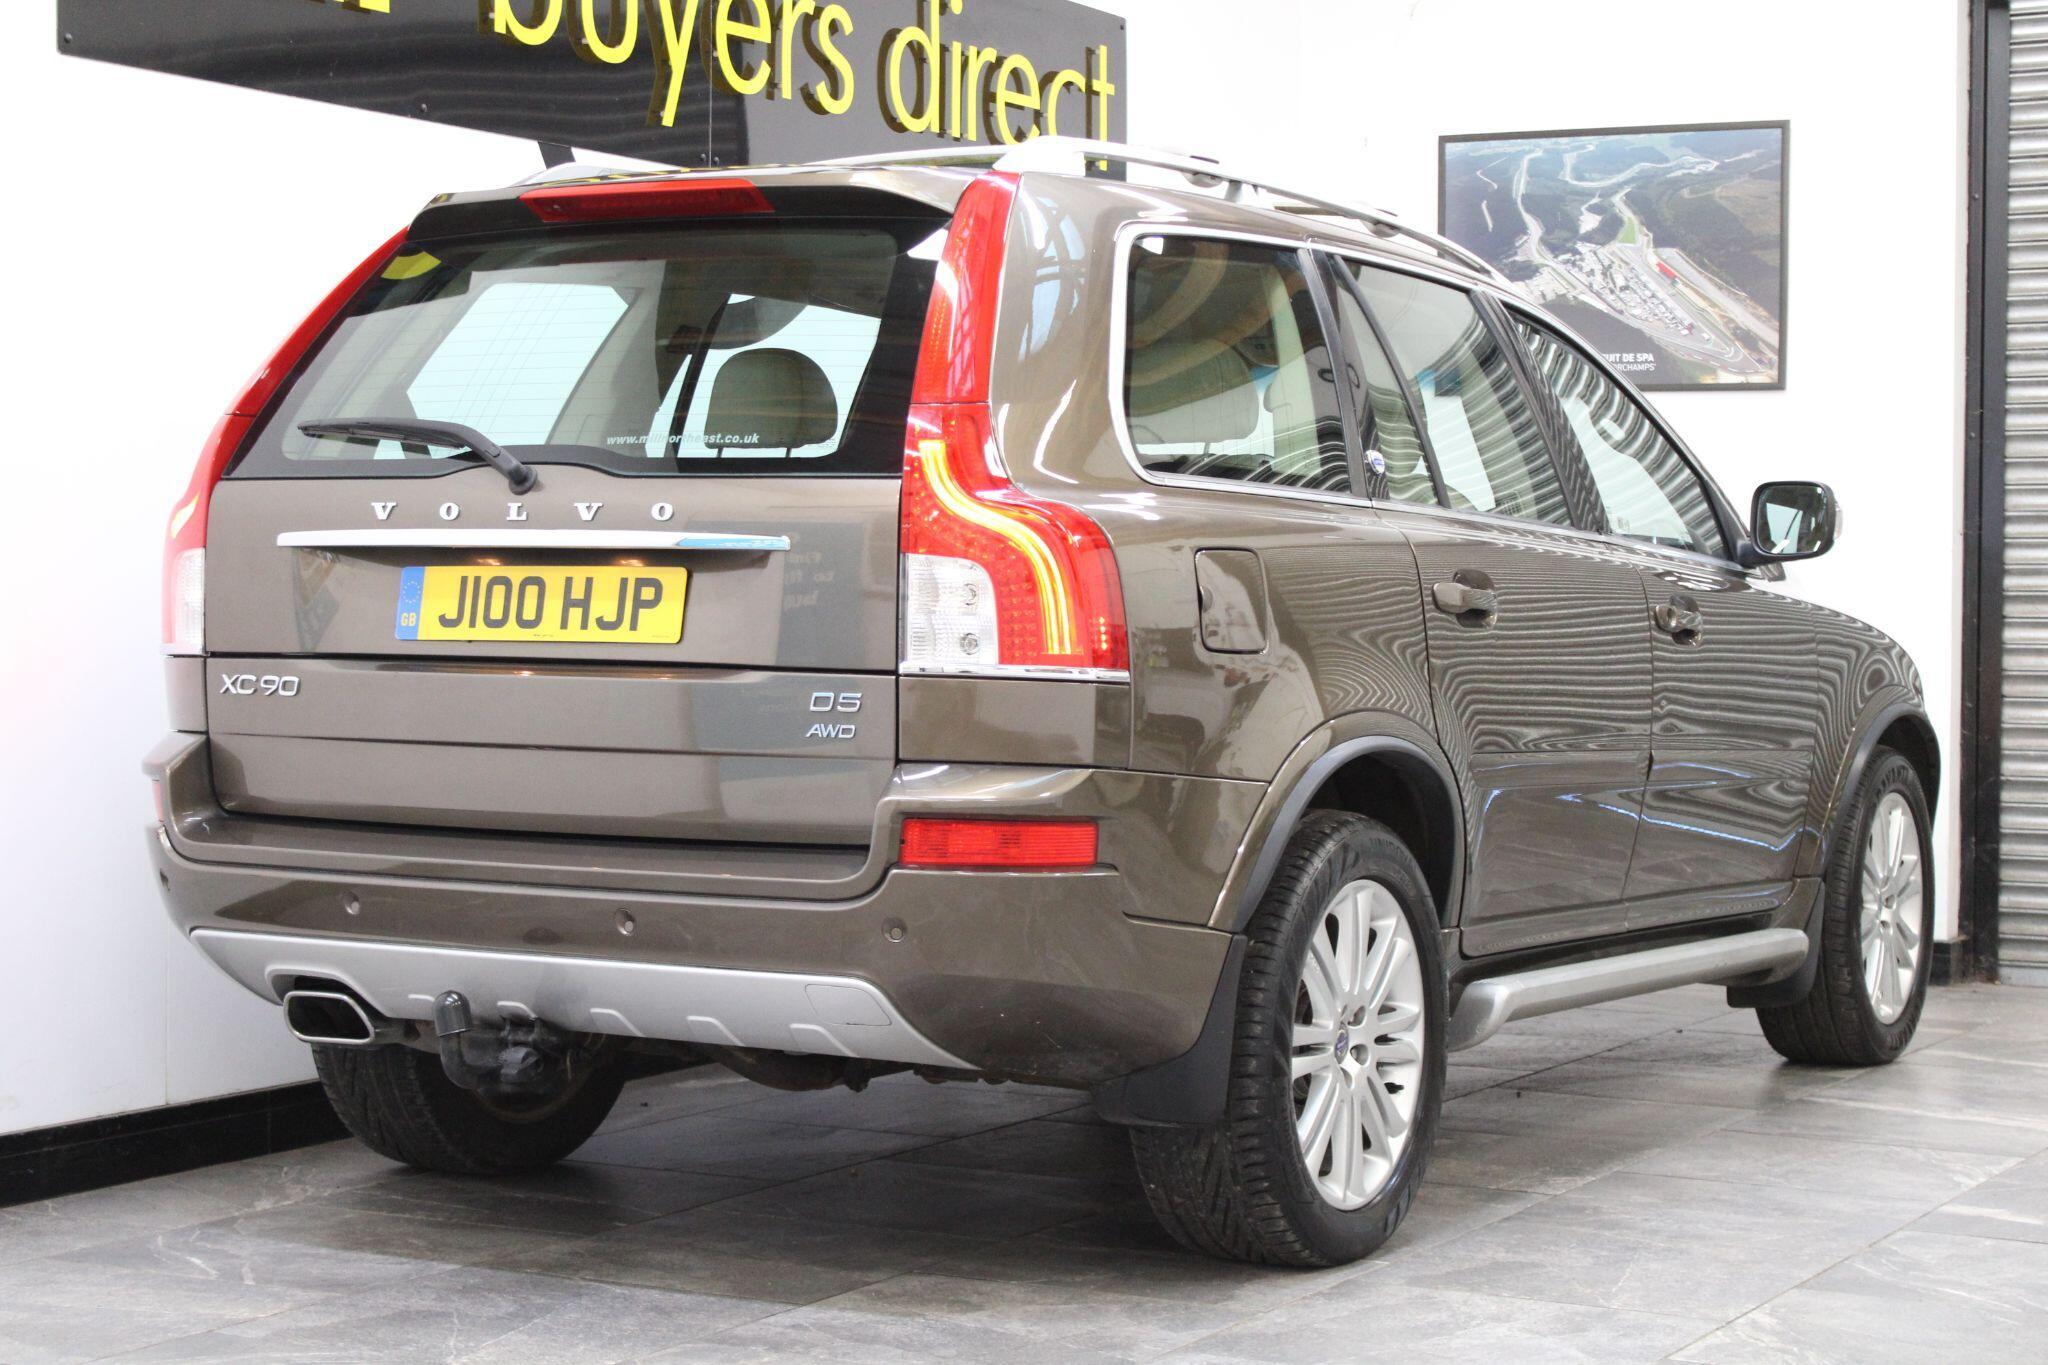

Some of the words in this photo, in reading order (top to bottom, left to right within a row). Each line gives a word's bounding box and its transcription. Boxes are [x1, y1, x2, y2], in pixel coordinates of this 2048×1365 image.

[494, 0, 855, 127] uyers
[889, 0, 1116, 171] direct
[1622, 353, 1635, 362] DE
[1636, 353, 1654, 362] SPA
[371, 502, 674, 521] VOLVO
[560, 576, 664, 632] HJP
[400, 612, 417, 628] GB
[809, 691, 863, 713] D5
[804, 723, 857, 739] AWD
